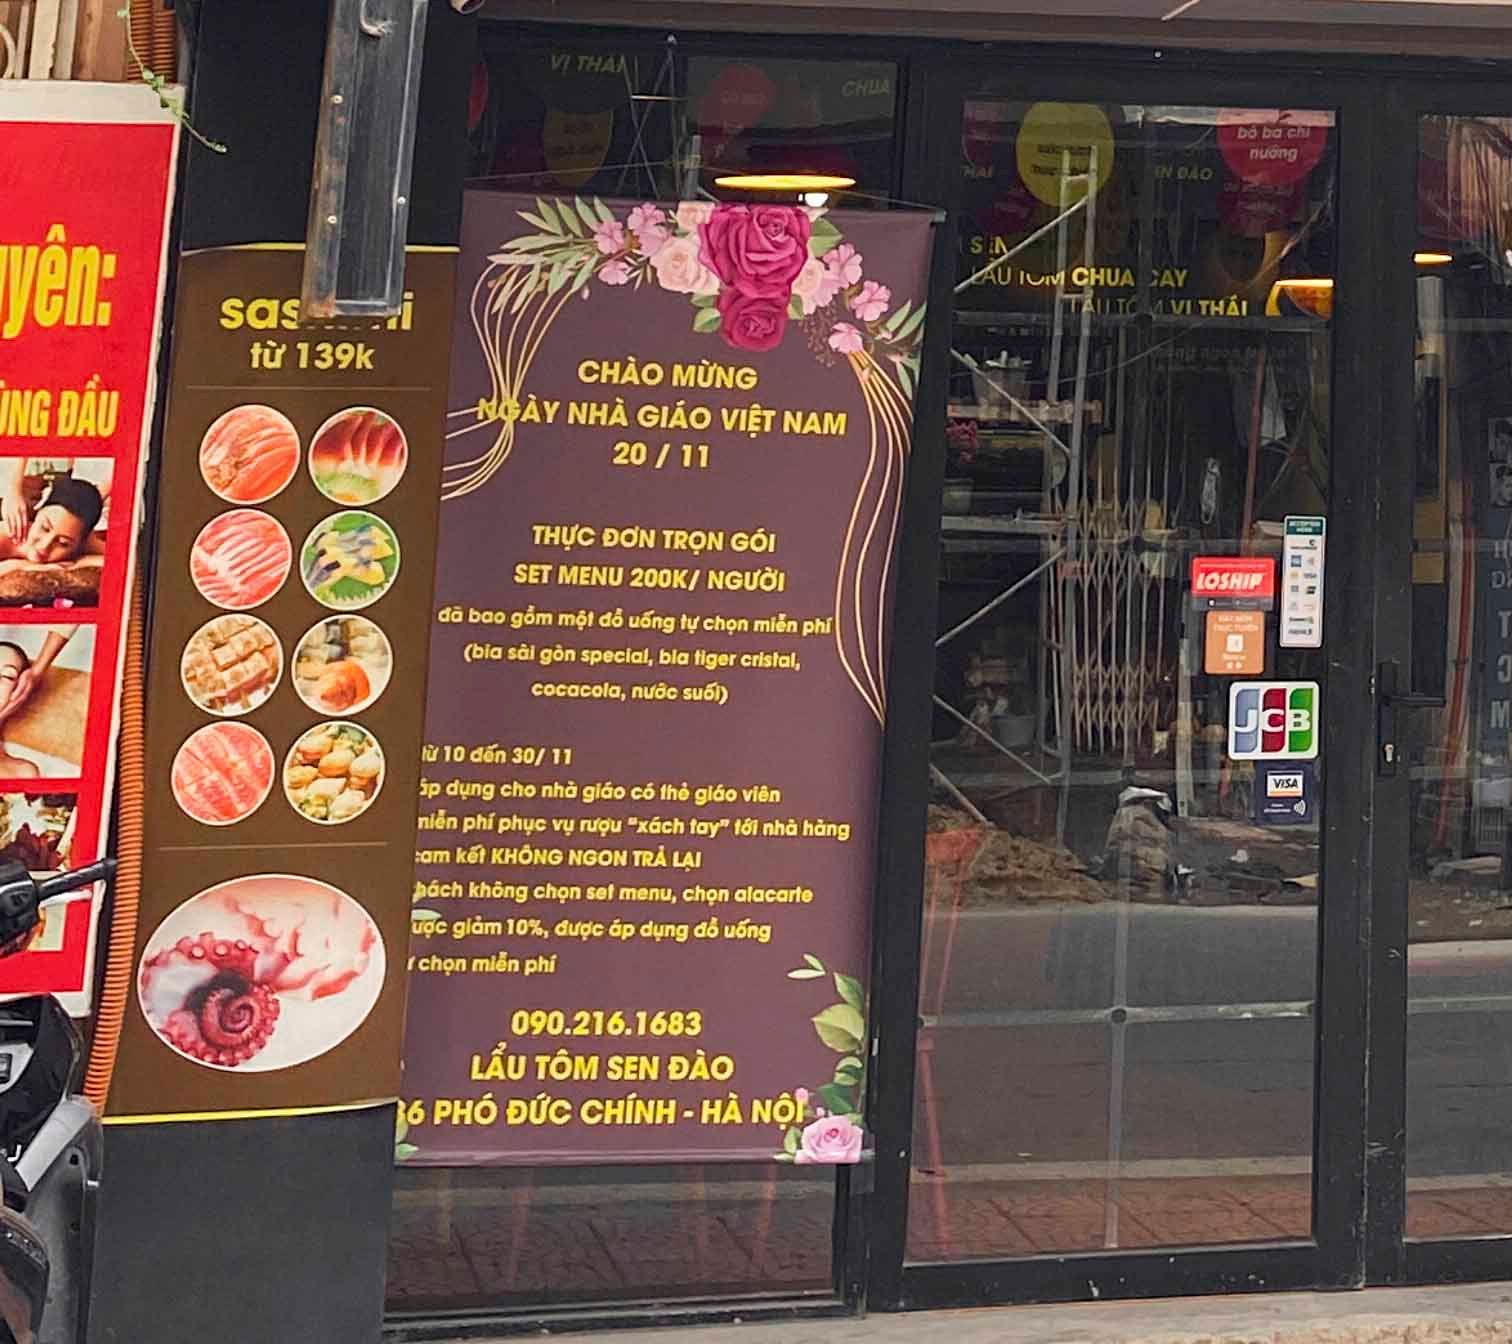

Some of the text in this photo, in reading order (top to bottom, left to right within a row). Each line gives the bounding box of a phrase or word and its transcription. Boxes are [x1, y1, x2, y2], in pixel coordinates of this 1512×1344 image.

[0, 223, 117, 340] yên:
[1071, 266, 1136, 288] CHUA
[219, 291, 414, 331] sasi
[250, 339, 376, 371] từ 139k
[579, 358, 758, 390] CHÀO MỪNG
[476, 394, 847, 438] NGÀY NHÀ GIÁO VIỆT NAM
[614, 441, 647, 465] 20
[682, 444, 709, 468] 11
[533, 525, 775, 555] THỰC ĐƠN TRỌN GÓI
[514, 563, 785, 592] SET MENU 200K/ NGƯỜI
[1196, 572, 1265, 591] LOSHIP
[439, 607, 464, 623] đã
[468, 608, 506, 624] bao
[558, 610, 595, 629] một
[598, 609, 624, 628] đồ
[628, 611, 676, 634] uống
[680, 615, 700, 633] tự
[703, 616, 749, 632] chọn
[802, 619, 832, 635] phí
[466, 643, 502, 660] (bia
[507, 644, 535, 661] sài
[539, 645, 577, 666] gòn
[580, 649, 653, 665] special,
[659, 649, 690, 665] bia
[694, 649, 737, 671] tiger
[532, 682, 728, 701] cocacola, nước suối)
[1233, 708, 1311, 733] JCB
[445, 745, 466, 762] 10
[469, 745, 507, 763] đến
[553, 748, 572, 764] 11
[445, 779, 496, 801] dụng
[500, 781, 537, 798] cho
[541, 781, 578, 799] nhà
[582, 783, 626, 803] giáo
[630, 784, 656, 801] có
[694, 784, 738, 806] giáo
[741, 785, 781, 803] viên
[1272, 777, 1299, 789] VISA
[462, 813, 496, 832] phí
[497, 815, 547, 834] phục
[552, 819, 575, 836] vụ
[579, 817, 622, 836] rượu
[734, 818, 759, 836] tới
[762, 818, 798, 836] nhà
[802, 820, 850, 841] hàng
[416, 844, 702, 870] am kết KHÔNG NGON TRẢ LẠI
[412, 880, 814, 905] hách không chọn set menu, chọn alacarte
[411, 919, 449, 938] ược
[452, 919, 503, 939] giảm
[554, 919, 605, 938] được
[608, 920, 636, 940] áp
[639, 922, 689, 943] dụng
[693, 917, 720, 939] đồ
[723, 920, 772, 943] uống
[418, 955, 467, 975] chọn
[471, 952, 520, 972] miễn
[524, 955, 556, 976] phí
[511, 1010, 702, 1036] 090.216.1683
[471, 1041, 734, 1081] LẨU TÔM SEN ĐÀO
[433, 1092, 806, 1130] PHÓ ĐỨC CHÍNH HÀ NỘI
